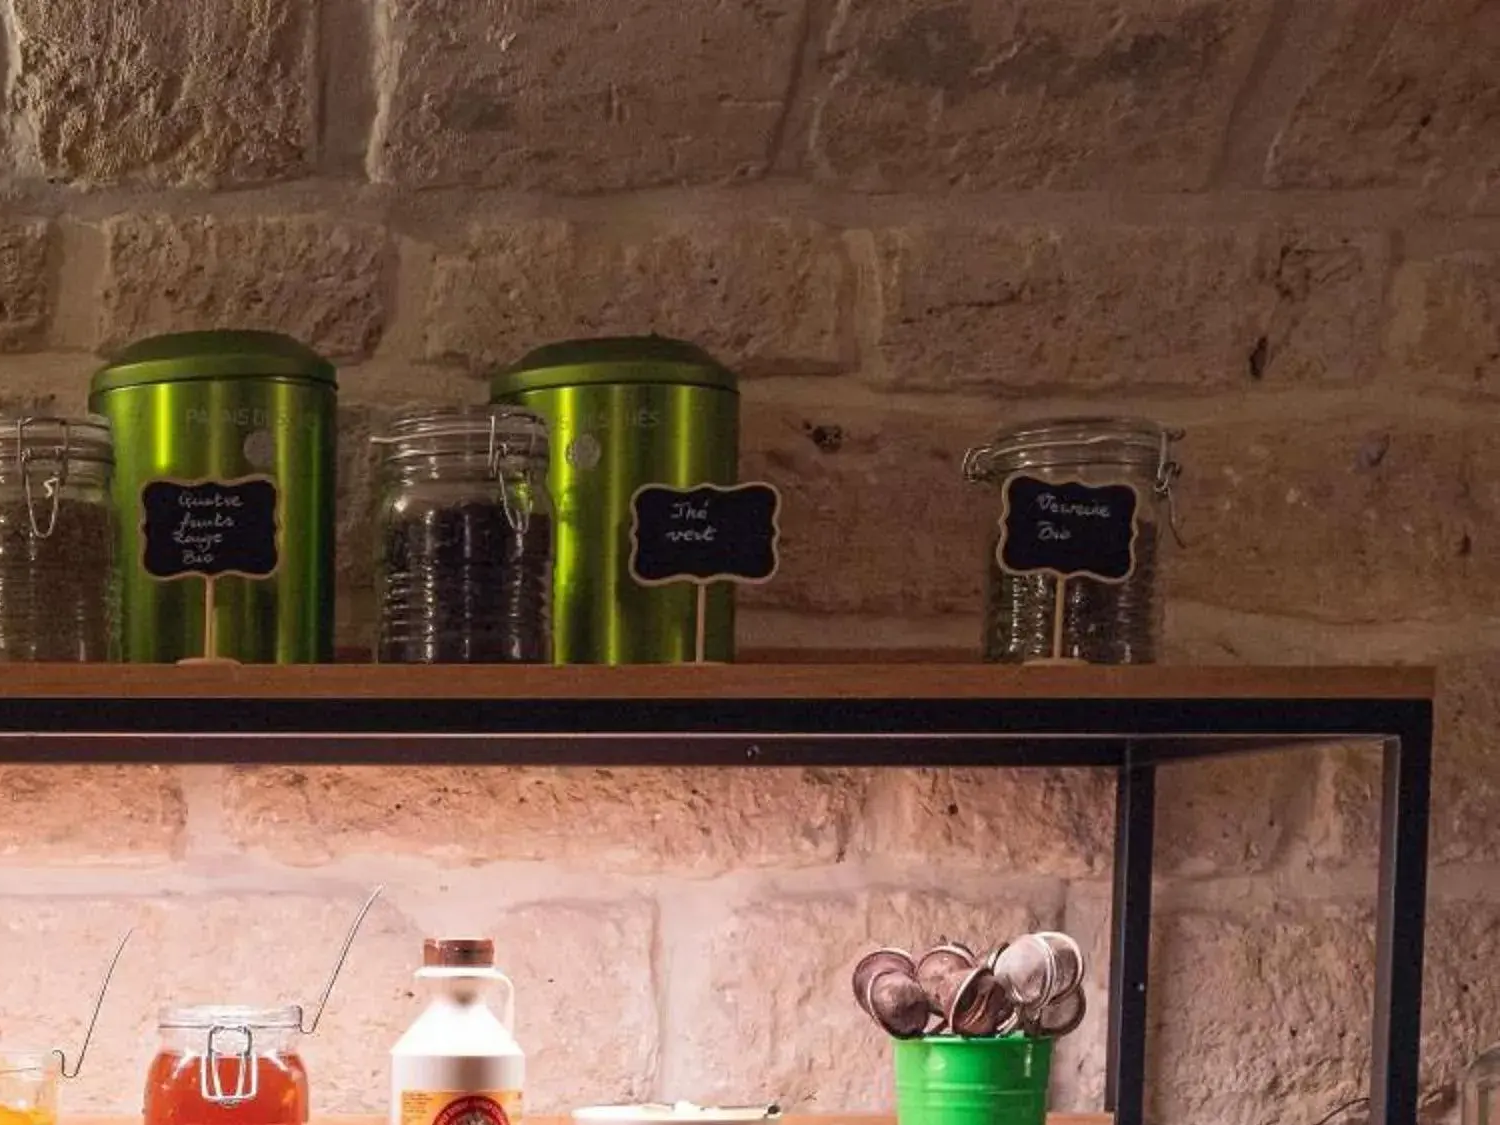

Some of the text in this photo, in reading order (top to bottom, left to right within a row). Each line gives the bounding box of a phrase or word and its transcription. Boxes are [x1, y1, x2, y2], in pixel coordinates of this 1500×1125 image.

[669, 499, 709, 520] Thé
[1036, 491, 1111, 518] Verveine
[665, 525, 718, 541] vert
[1036, 520, 1072, 541] Bio
[182, 549, 215, 564] Bio
